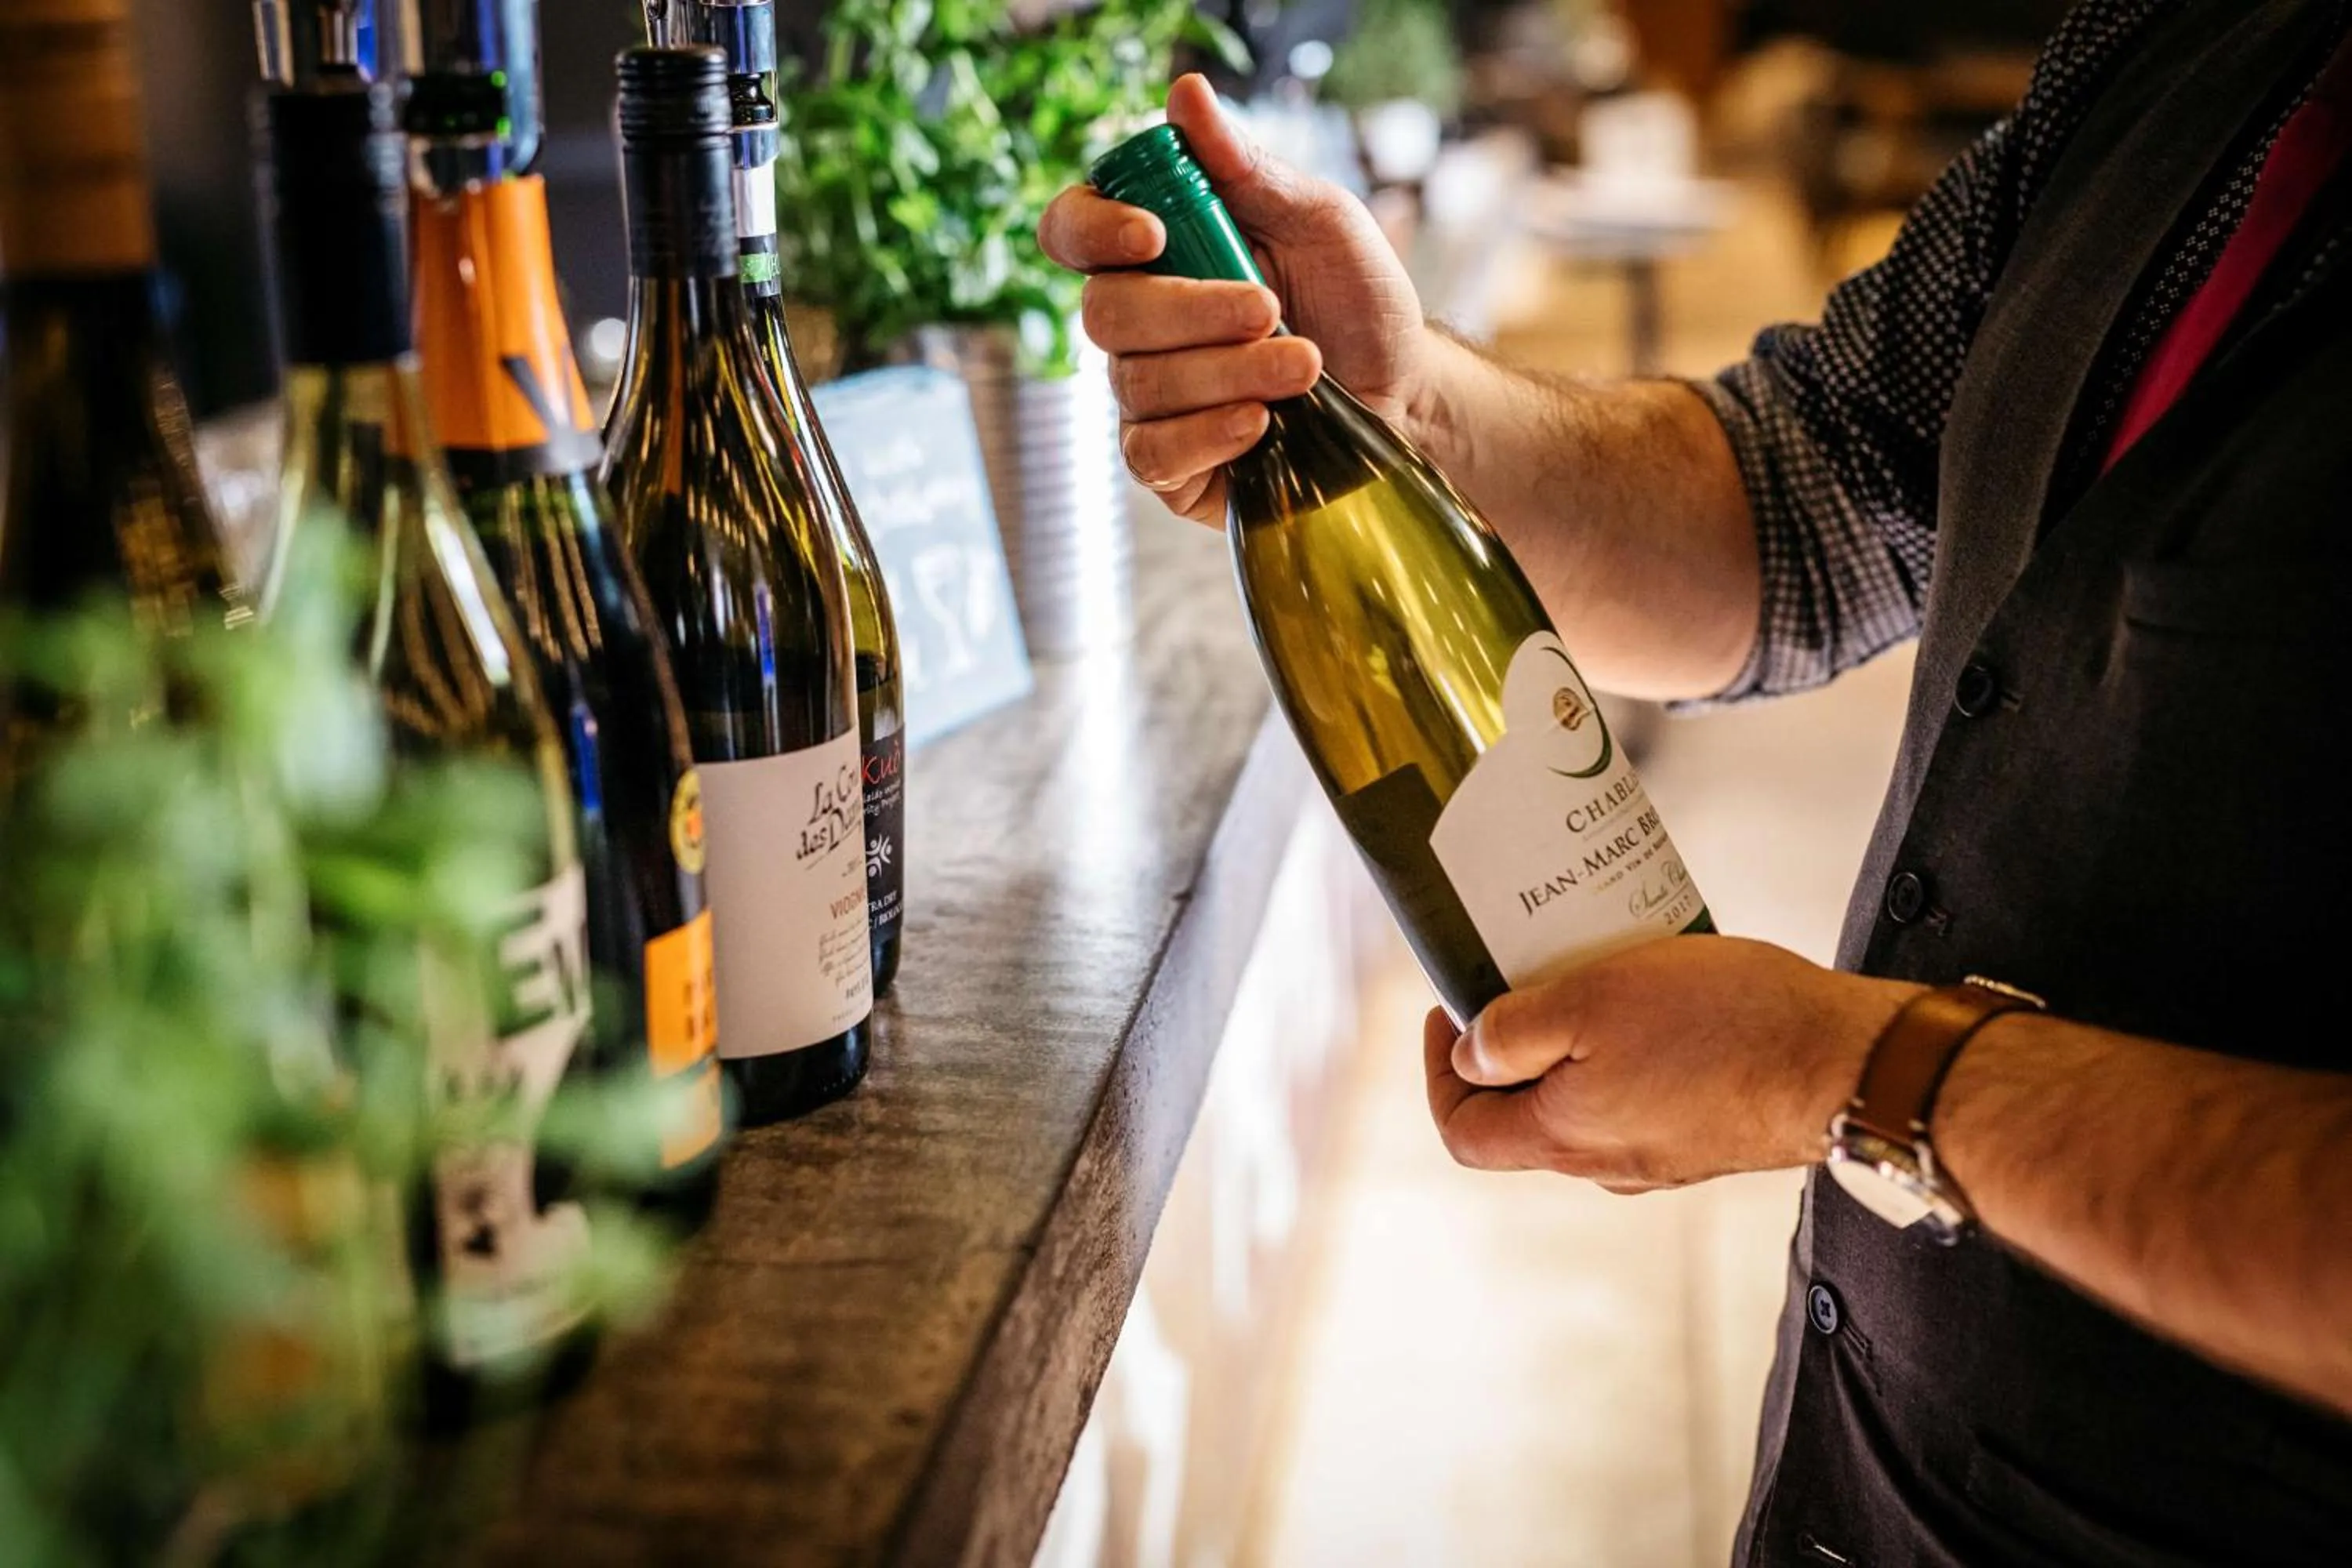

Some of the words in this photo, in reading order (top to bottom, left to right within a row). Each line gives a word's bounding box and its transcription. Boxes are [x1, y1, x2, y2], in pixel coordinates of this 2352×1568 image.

[808, 781, 833, 826] La
[796, 829, 828, 861] des
[1519, 826, 1640, 916] JEAN-MARC
